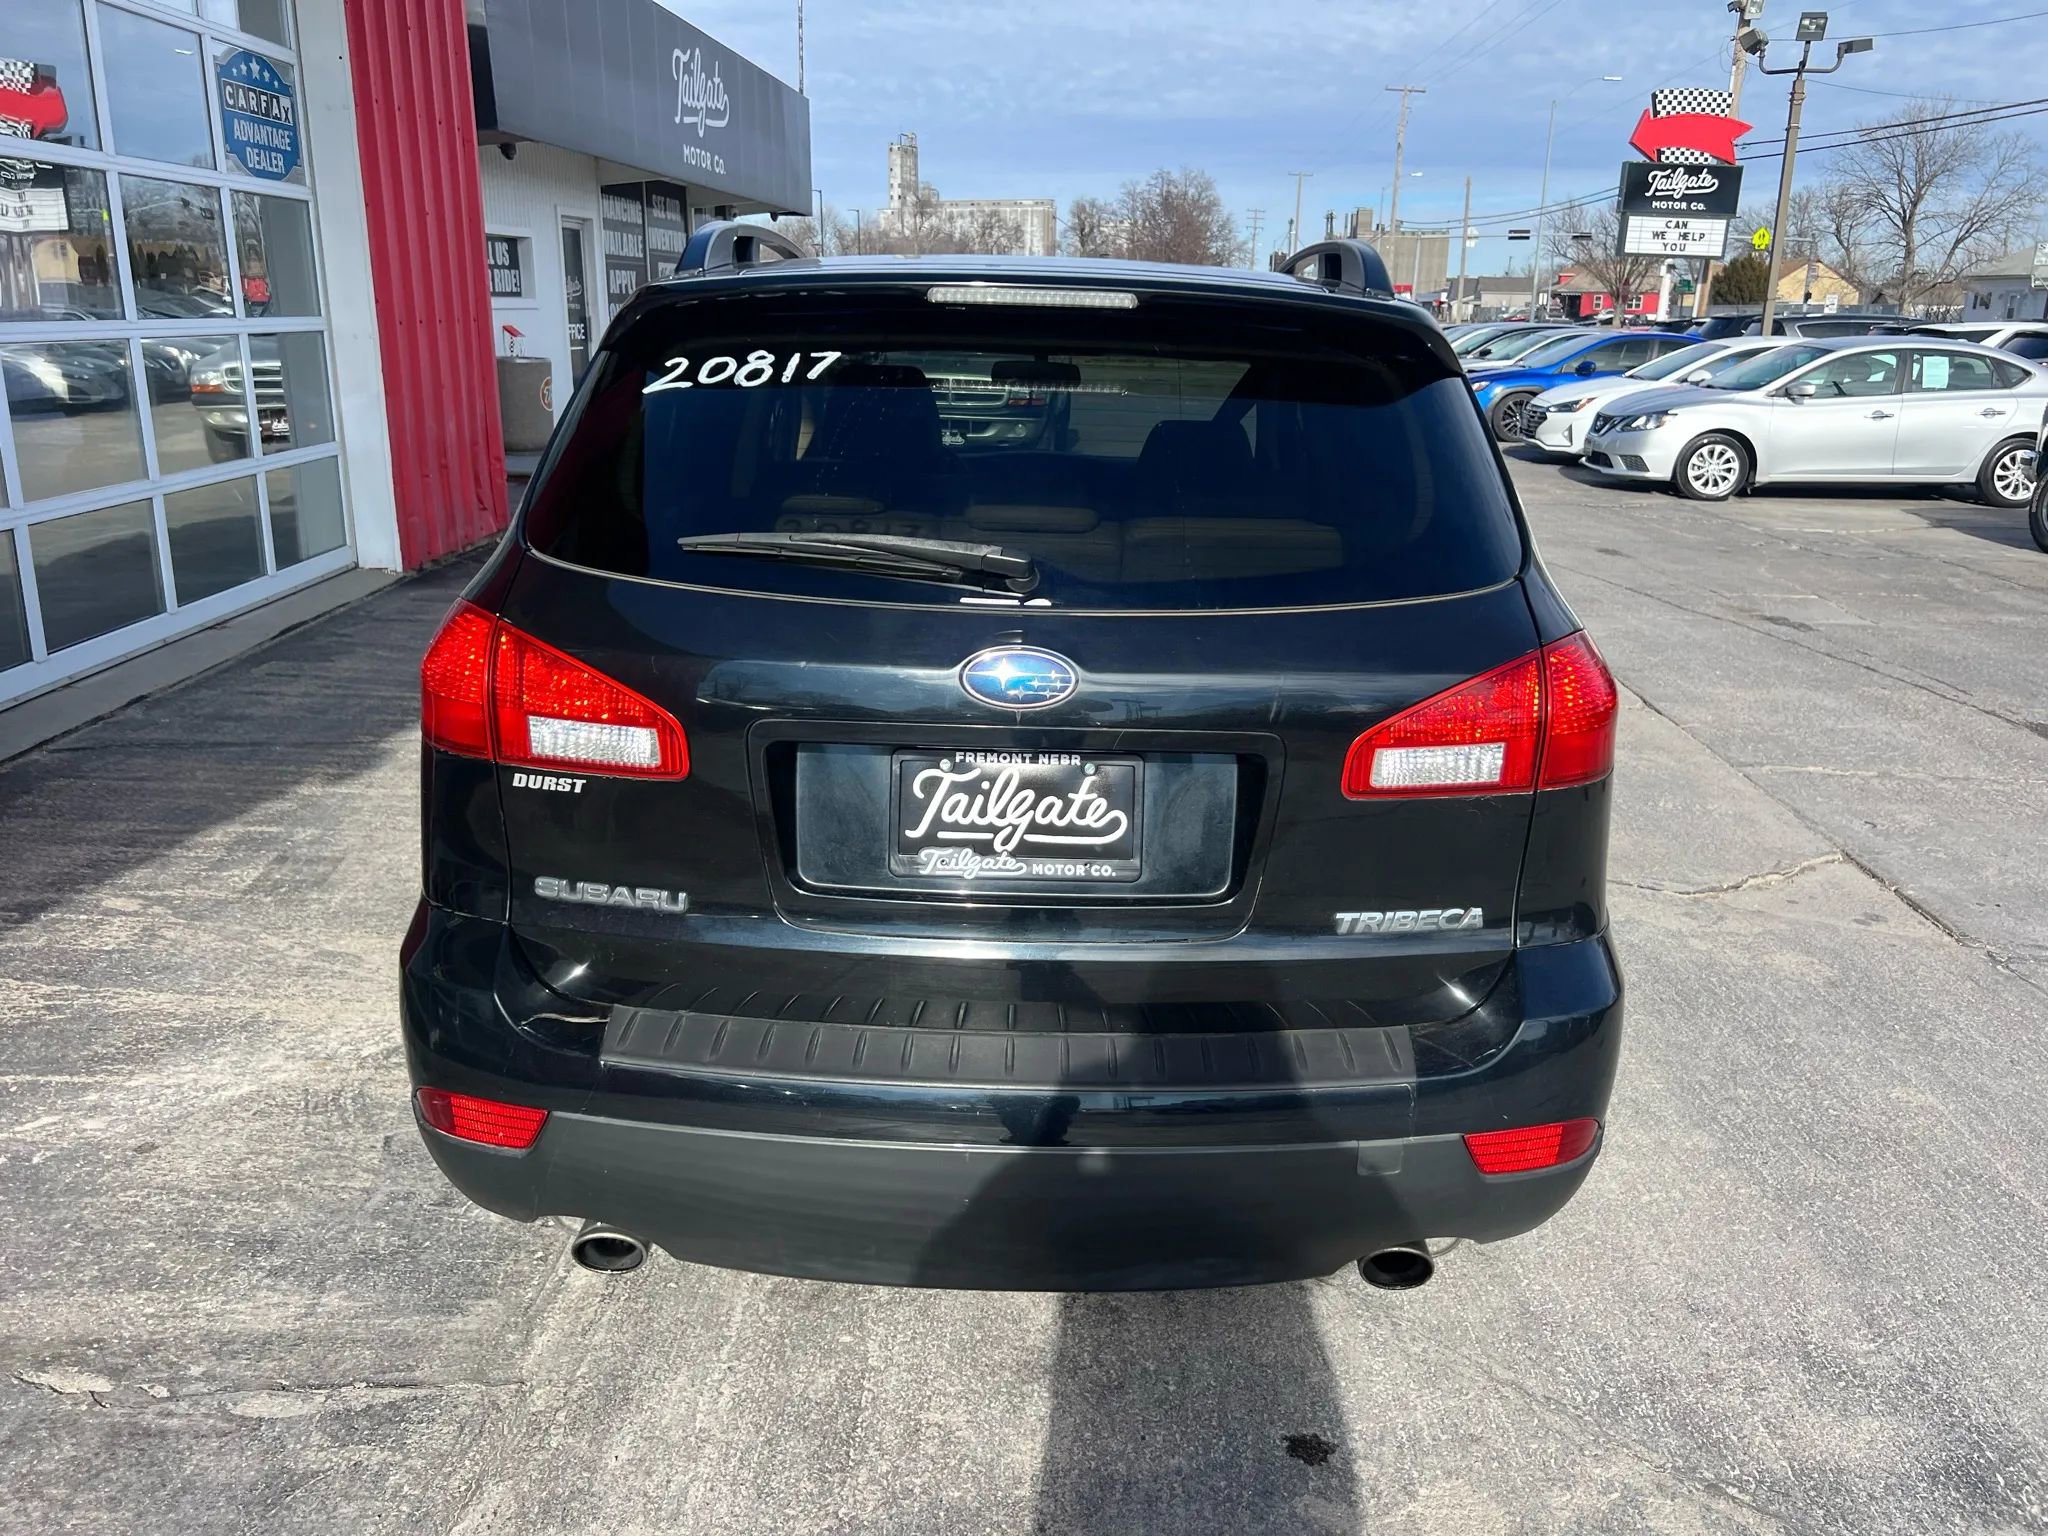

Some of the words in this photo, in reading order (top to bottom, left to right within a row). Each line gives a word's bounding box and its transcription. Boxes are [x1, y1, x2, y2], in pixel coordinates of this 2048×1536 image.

[225, 84, 292, 124] CARFAX
[672, 47, 730, 138] Tailgate
[234, 118, 292, 151] ADVANTAGE
[245, 146, 286, 174] DEALER
[683, 143, 712, 172] MOTOR
[713, 154, 727, 175] CO.
[1644, 166, 1719, 199] Tailgate
[1651, 200, 1687, 210] MOTOR
[1690, 201, 1707, 211] CO.
[1652, 230, 1668, 241] WE
[1678, 231, 1706, 242] HELP
[1665, 220, 1689, 230] CAN
[494, 241, 510, 266] US
[1662, 242, 1687, 252] YOU
[493, 268, 521, 293] RIDE!
[609, 269, 637, 295] APPLY
[641, 349, 842, 395] 20817
[955, 751, 1032, 765] FREMONT
[1038, 752, 1082, 766] NEBR
[512, 773, 587, 794] DURST
[904, 766, 1129, 853] Tailgate
[919, 847, 1027, 880] Tailgate
[1031, 862, 1089, 877] MOTOR
[1090, 864, 1117, 877] CO.
[534, 875, 690, 914] SUBARU
[1335, 906, 1483, 936] TRIBECA
